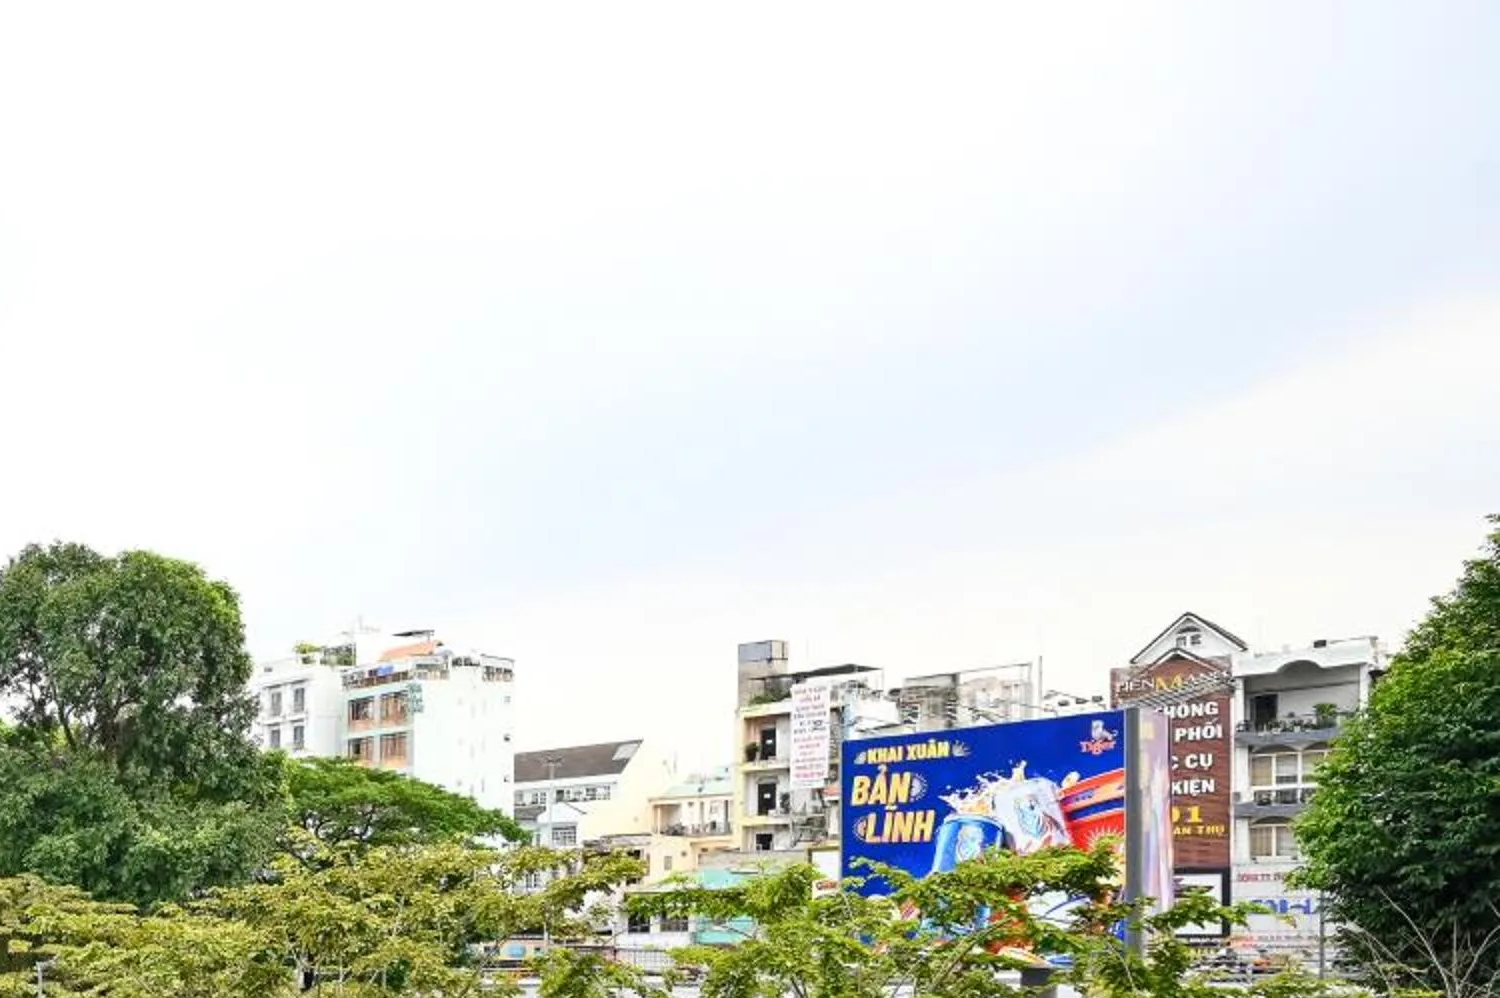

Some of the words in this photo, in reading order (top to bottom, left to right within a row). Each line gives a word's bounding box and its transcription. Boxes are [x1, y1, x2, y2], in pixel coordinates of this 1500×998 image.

[1175, 718, 1223, 741] PHỐI
[867, 746, 903, 764] KHAI
[906, 739, 949, 760] XUÂN
[1185, 753, 1213, 770] CỤ
[851, 764, 911, 806] BẢN
[1171, 777, 1215, 796] KIỆN
[865, 804, 935, 842] LĨNH
